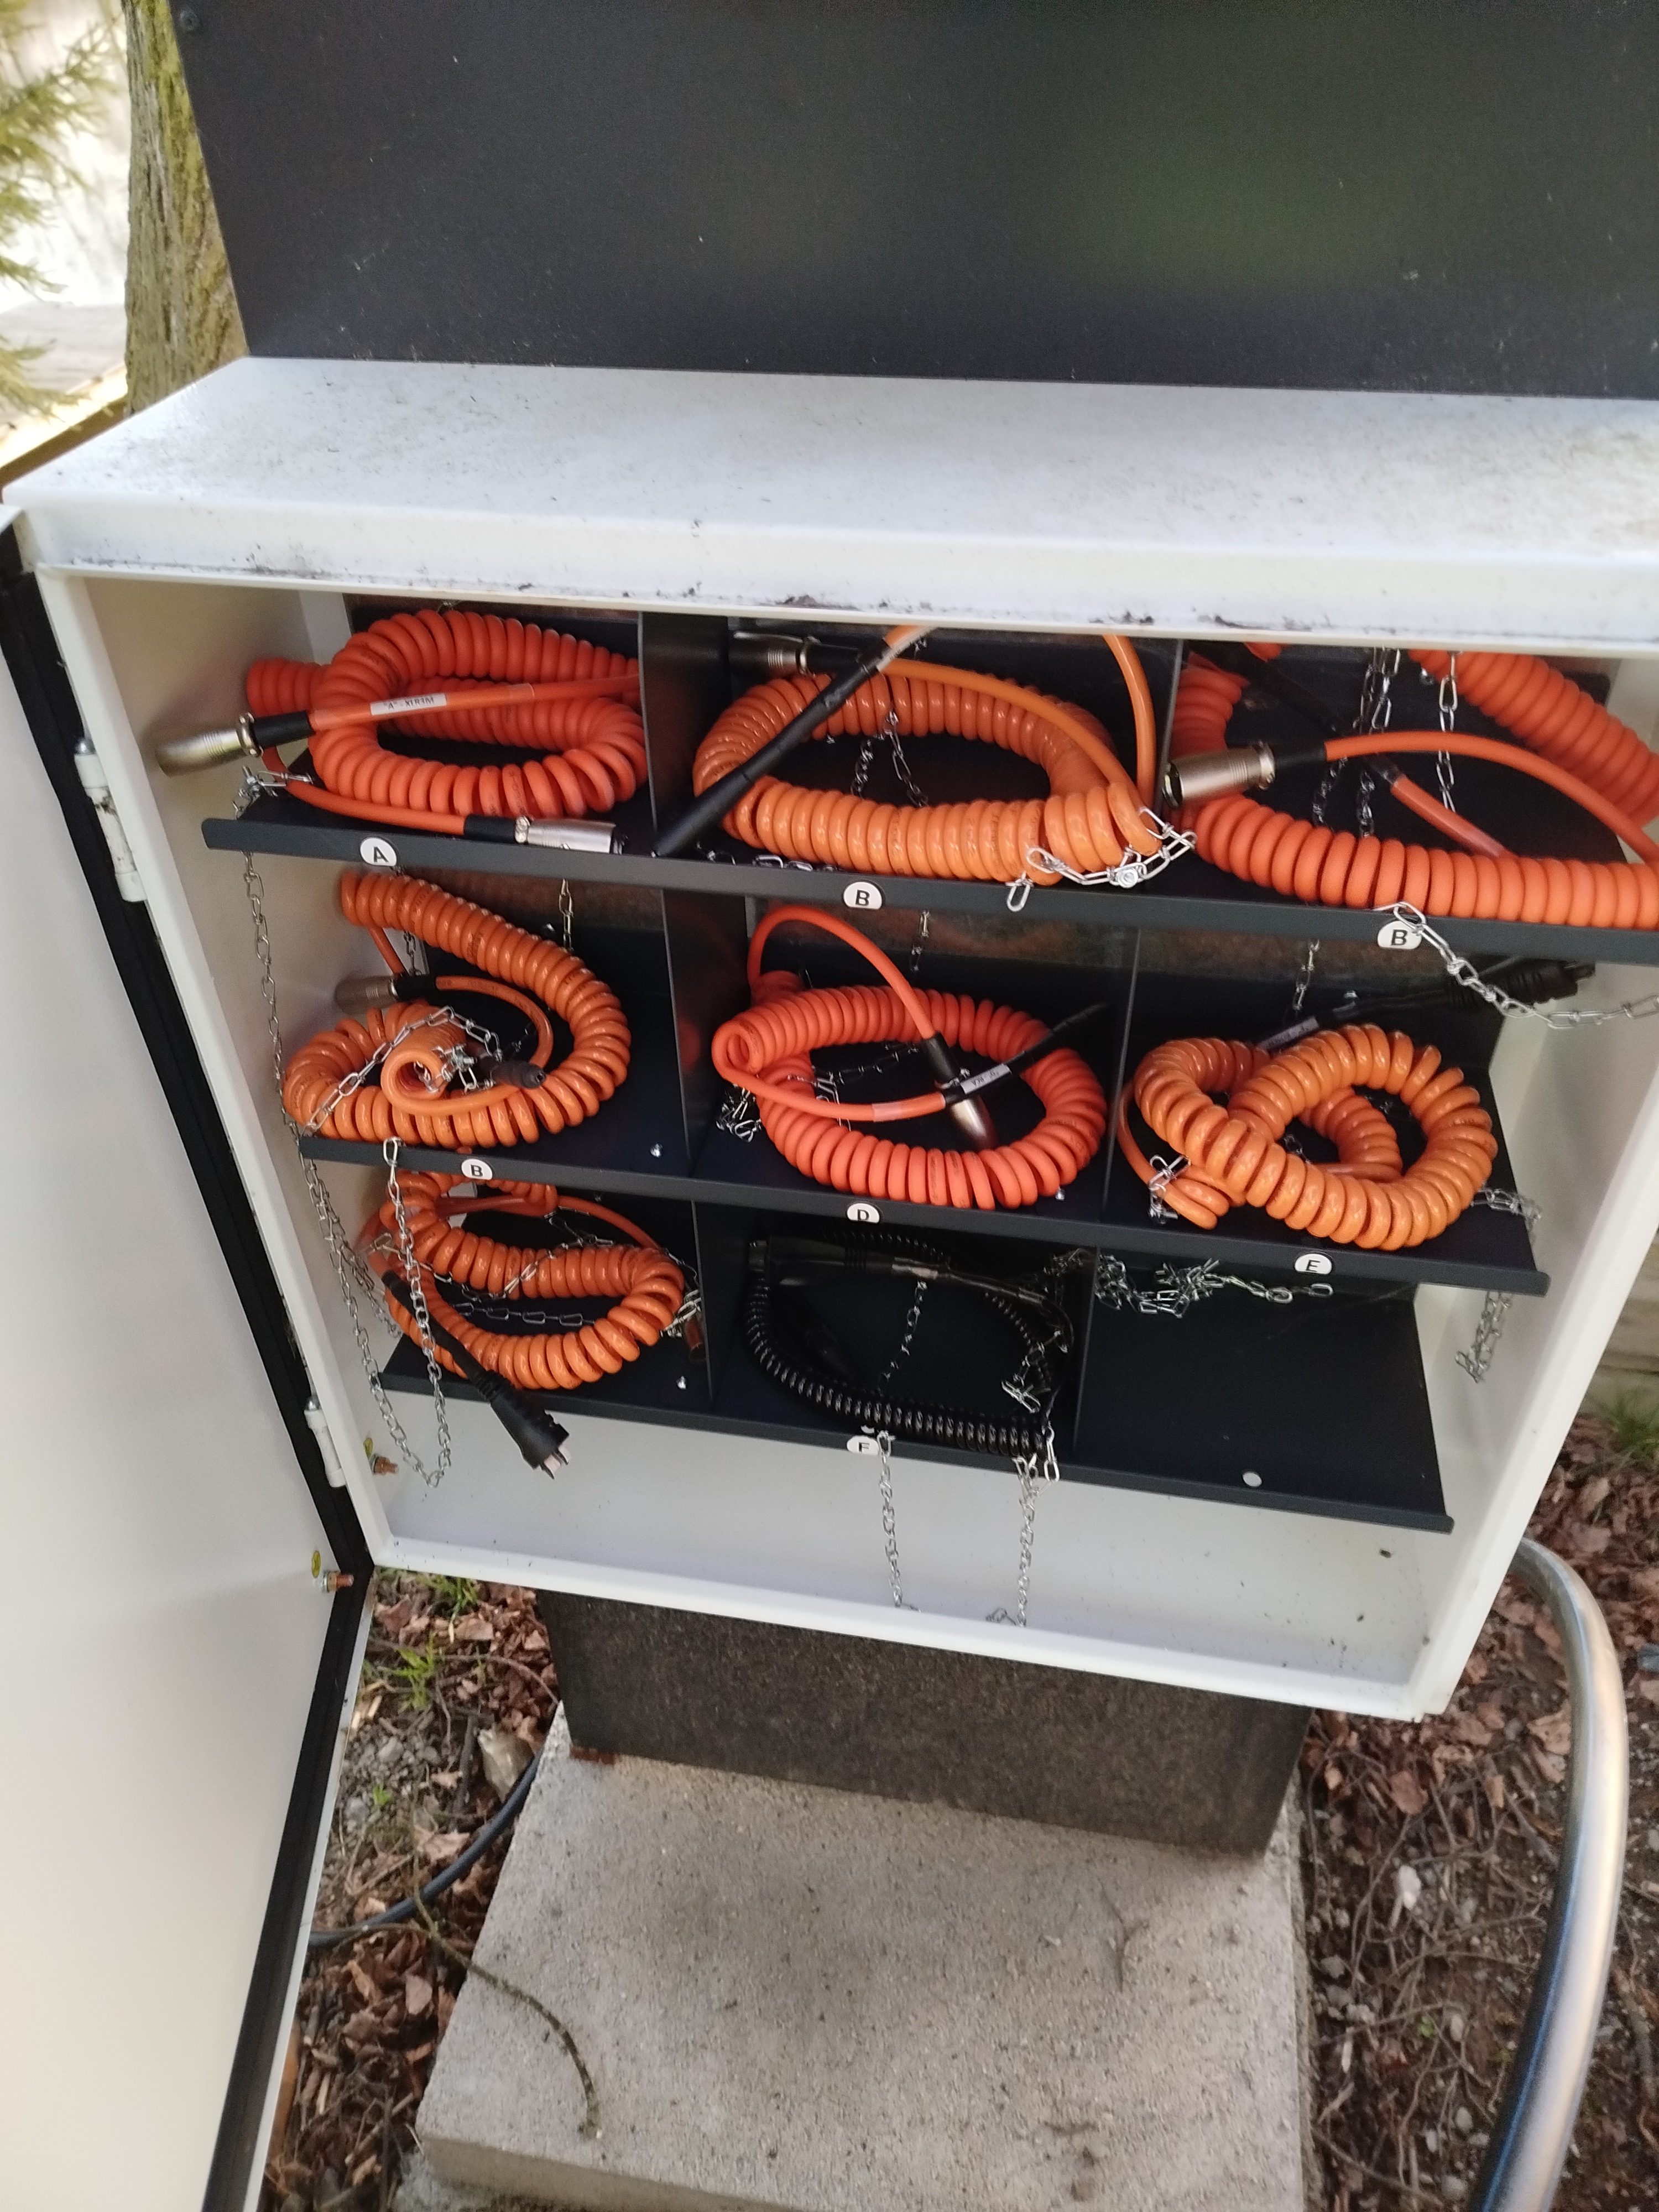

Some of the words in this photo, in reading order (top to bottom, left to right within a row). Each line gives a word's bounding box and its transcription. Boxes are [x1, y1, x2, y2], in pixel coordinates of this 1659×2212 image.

[372, 846, 389, 863] A
[855, 890, 870, 906] B
[1391, 929, 1407, 946] B
[470, 1164, 483, 1177] B
[857, 1209, 870, 1221] D
[1305, 1260, 1320, 1272] E
